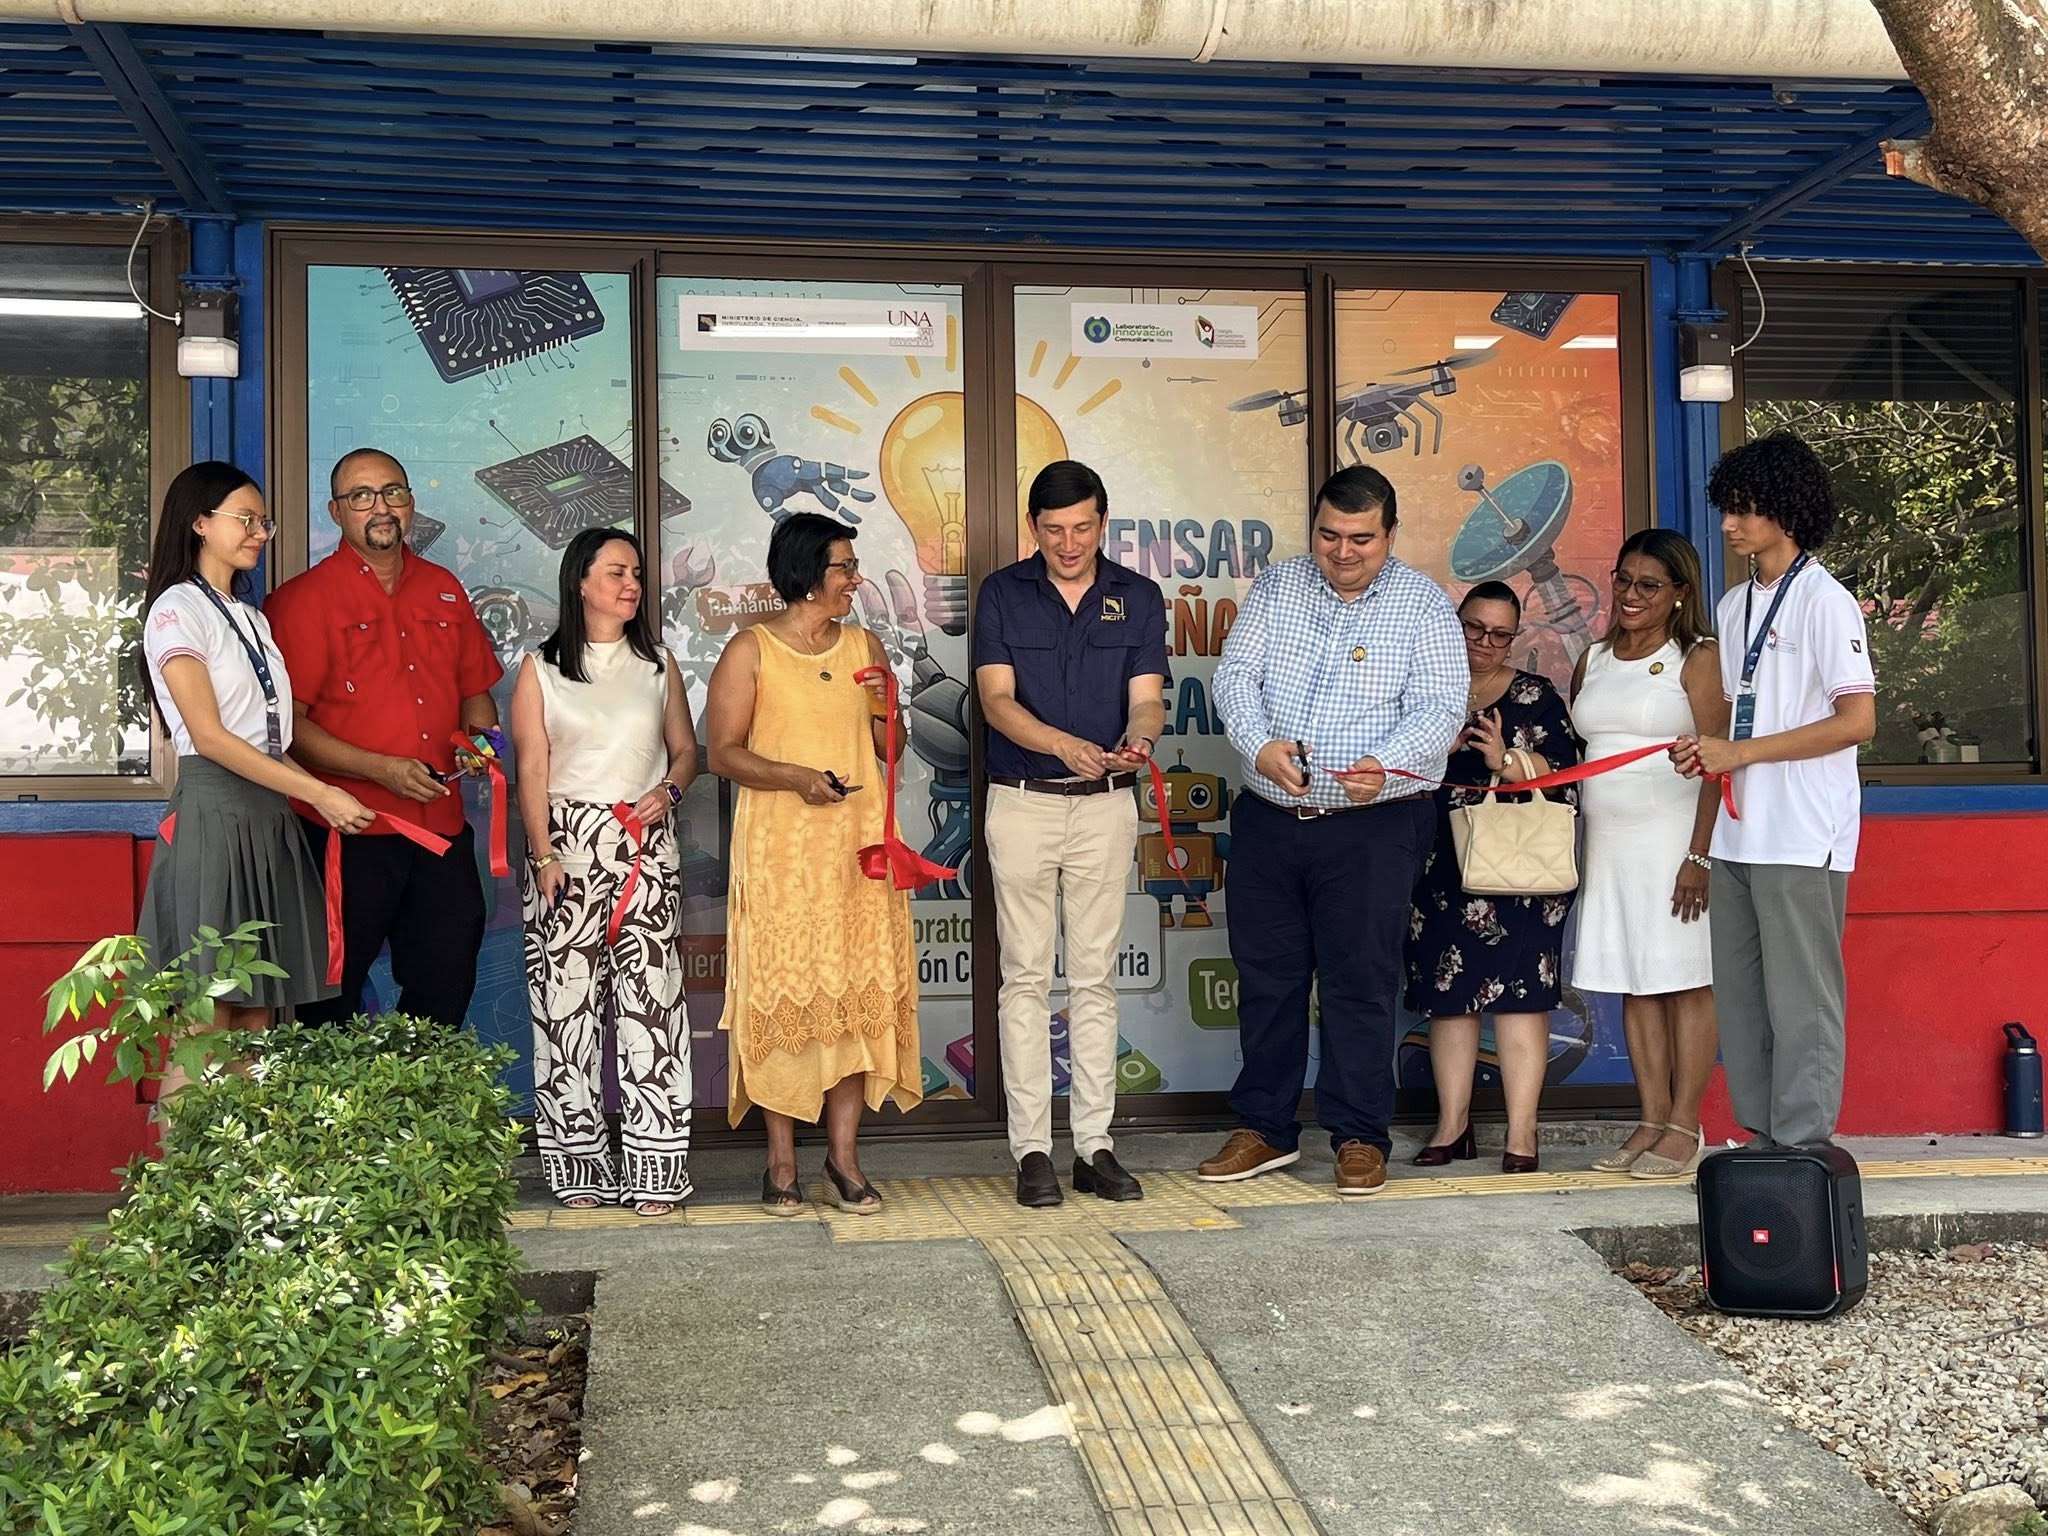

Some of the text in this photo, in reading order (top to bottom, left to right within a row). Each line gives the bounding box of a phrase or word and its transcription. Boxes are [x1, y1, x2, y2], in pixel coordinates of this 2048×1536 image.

[887, 310, 932, 326] UNA
[1112, 327, 1173, 337] Innovación
[1101, 518, 1274, 579] ENSAR
[708, 594, 788, 617] Humanis
[681, 944, 726, 978] ierí
[1114, 944, 1150, 977] ria
